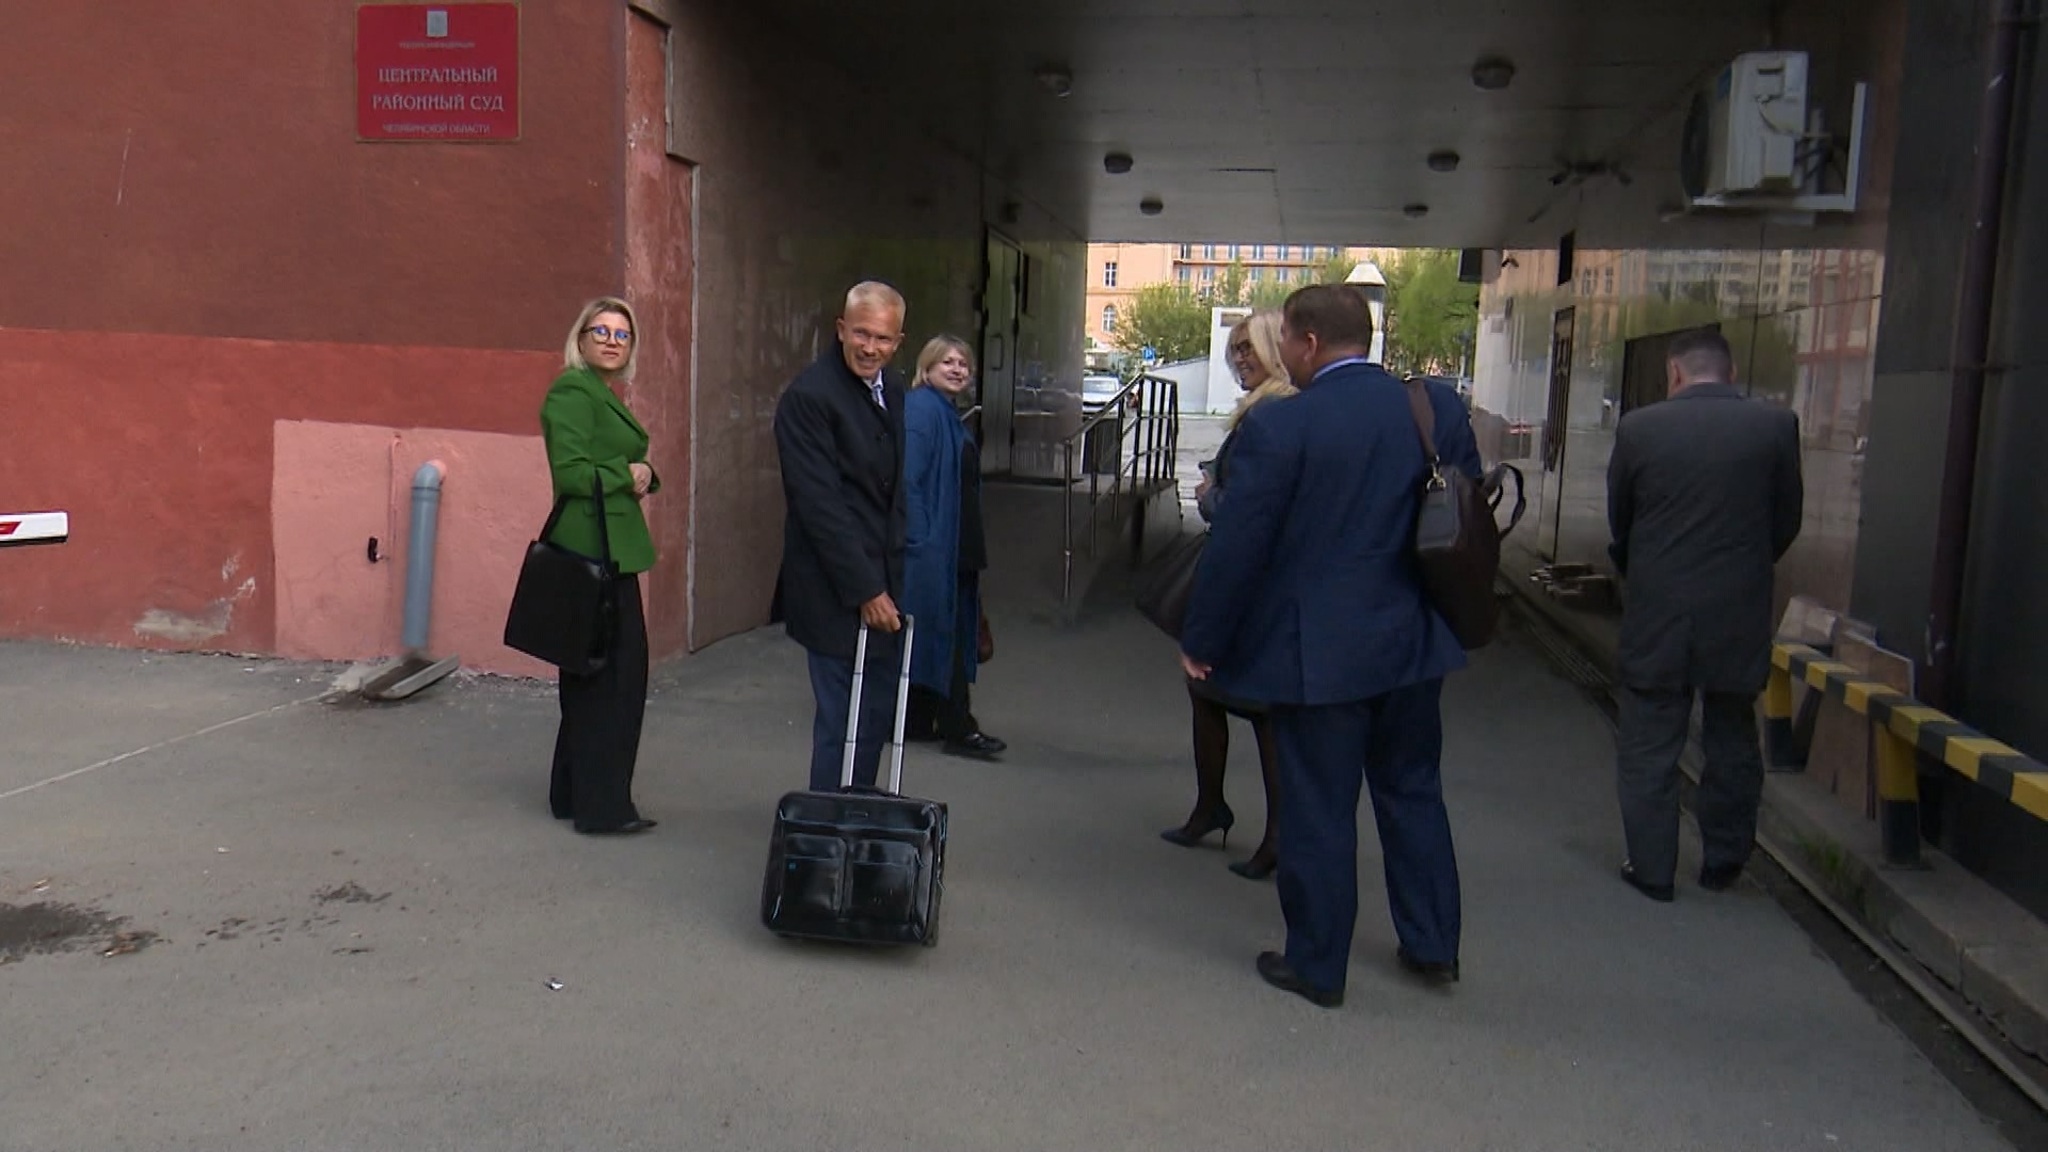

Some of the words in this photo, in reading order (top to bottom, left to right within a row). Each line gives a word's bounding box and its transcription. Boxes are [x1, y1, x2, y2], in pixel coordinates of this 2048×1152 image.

[378, 67, 497, 84] ЦЕНТРАЛЬНЫЙ
[372, 94, 465, 110] РАЙОННЫЙ
[470, 95, 504, 112] СУД
[449, 123, 490, 134] ОБЛАСТИ
